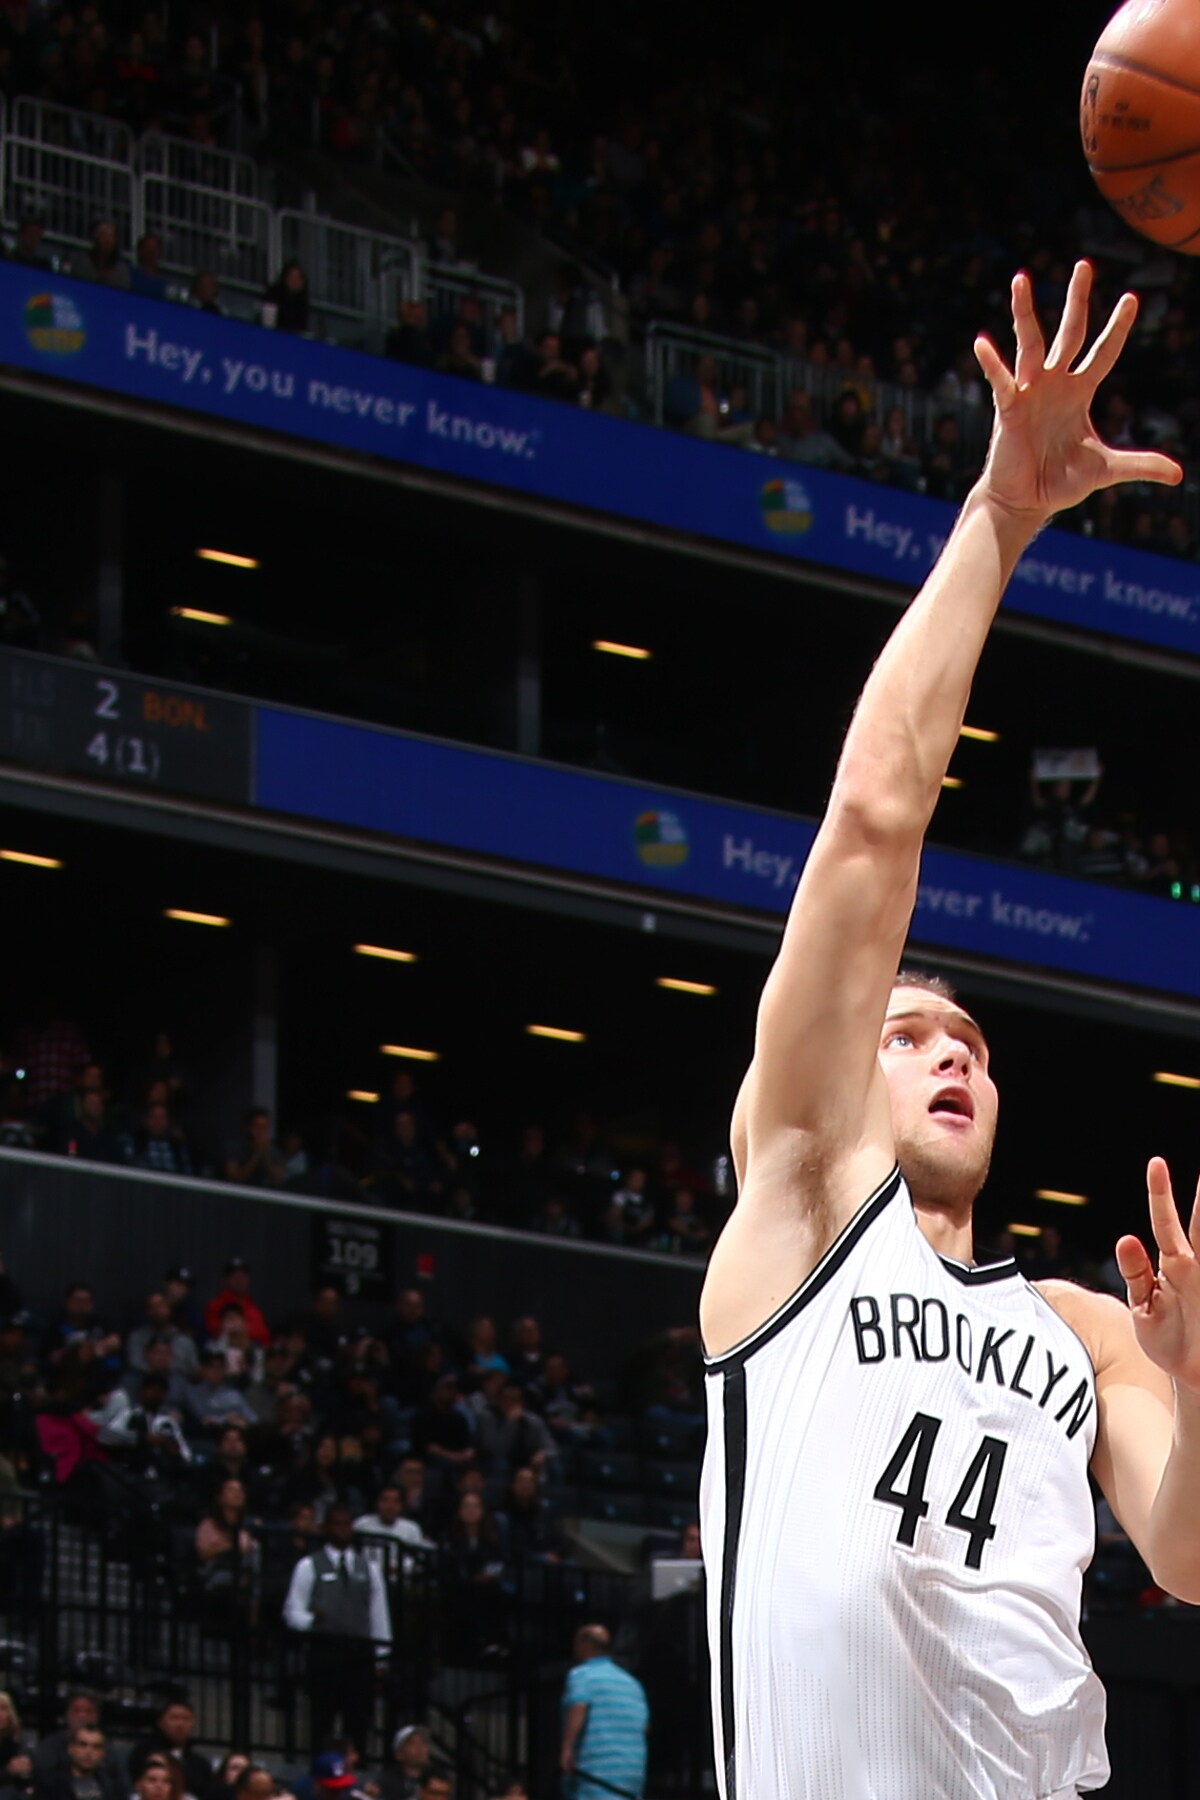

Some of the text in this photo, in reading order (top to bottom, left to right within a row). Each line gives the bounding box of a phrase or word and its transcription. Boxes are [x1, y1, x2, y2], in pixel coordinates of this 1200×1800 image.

[124, 322, 212, 385] Hey,
[221, 356, 295, 400] you
[307, 379, 413, 427] never
[844, 503, 922, 558] Hey,
[1014, 557, 1096, 597] ever
[94, 679, 120, 720] 2
[85, 731, 161, 780] 4(1)
[328, 1237, 379, 1270] 109
[850, 1293, 1094, 1441] BROOKLYN
[873, 1411, 1008, 1571] 44
